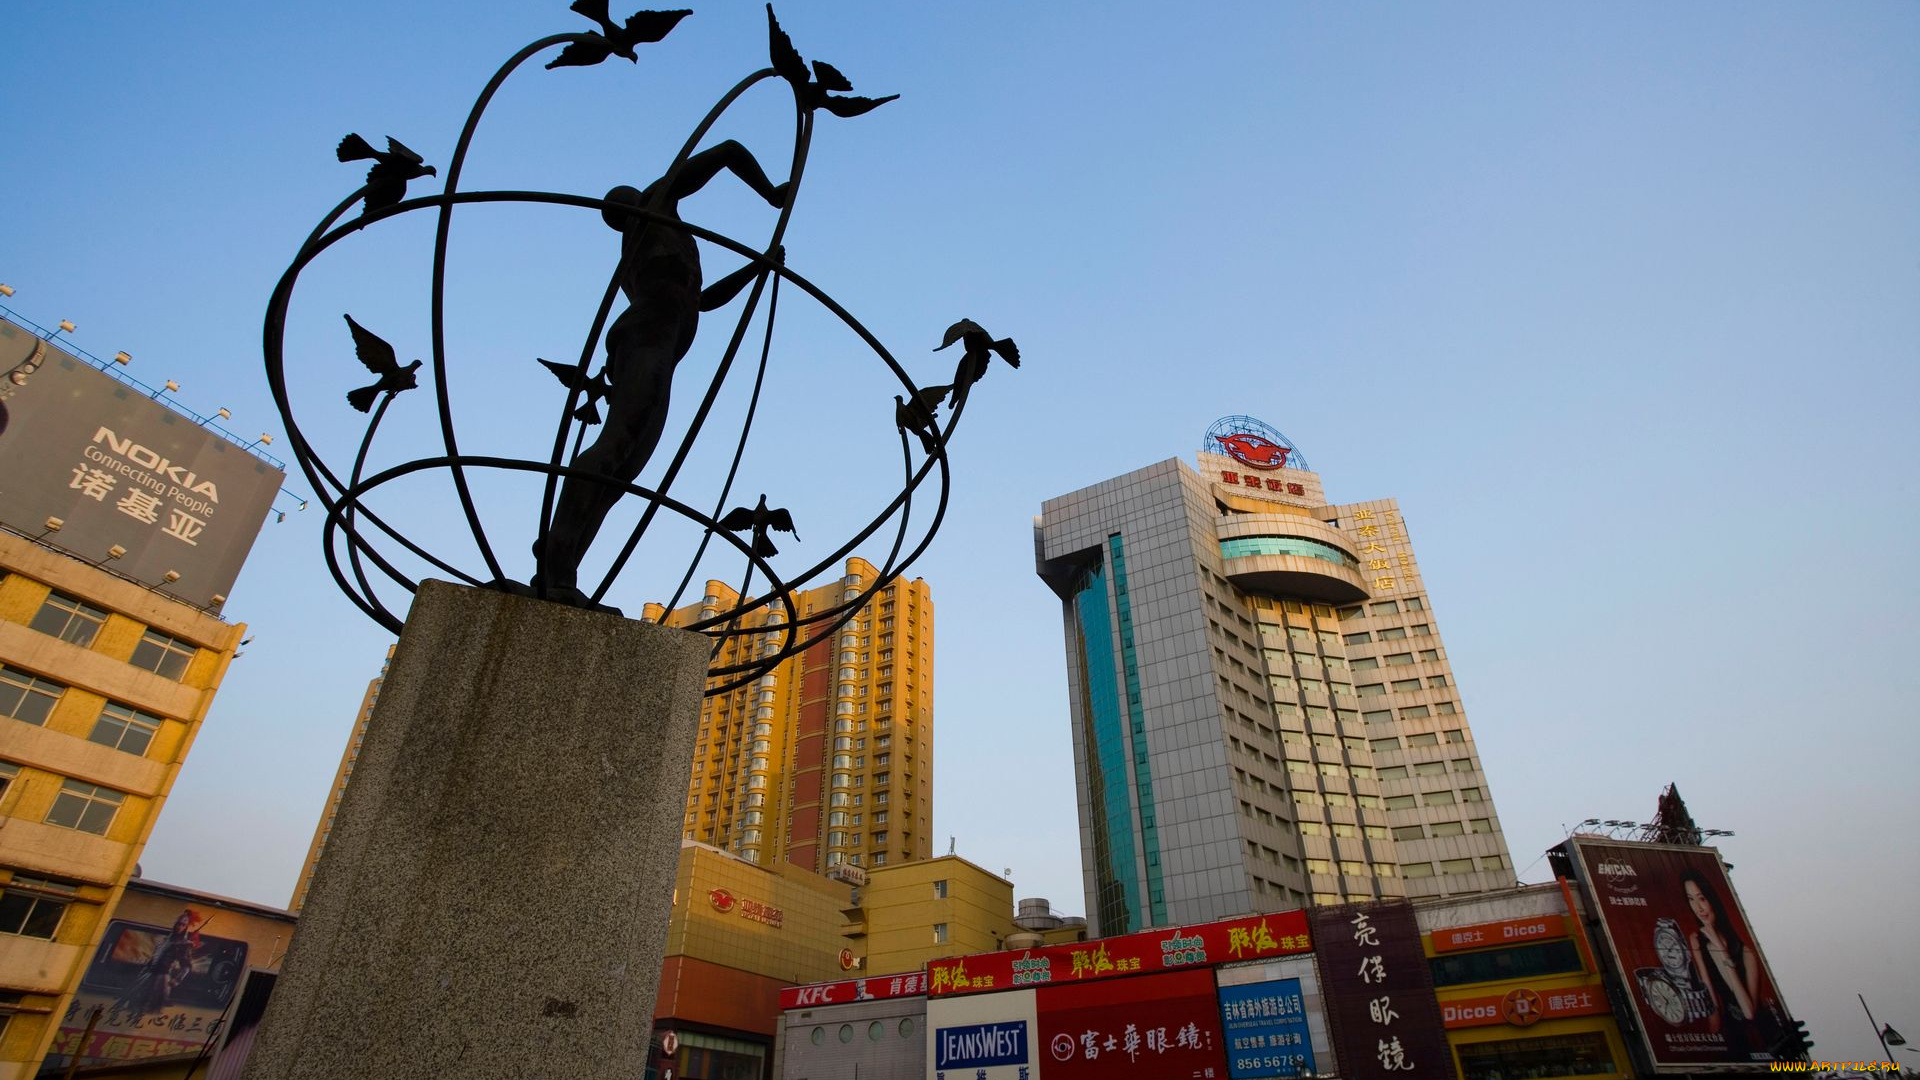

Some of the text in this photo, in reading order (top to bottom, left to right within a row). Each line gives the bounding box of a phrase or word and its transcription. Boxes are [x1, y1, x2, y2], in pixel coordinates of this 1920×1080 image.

[92, 426, 219, 504] NOKIA
[84, 444, 214, 518] Connecting People
[68, 463, 207, 547] 诺基亚
[1354, 509, 1395, 590] 亚泰大饭店
[1598, 863, 1637, 876] ENICAR
[1503, 923, 1546, 938] Dicos
[796, 985, 836, 1005] KFC
[1548, 992, 1593, 1011] 德克士
[1224, 994, 1302, 1021] 吉林省海外旅游总公司
[1443, 1004, 1497, 1021] Dicos
[941, 1025, 1020, 1066] JEANSWEST
[1237, 1057, 1261, 1070] 856
